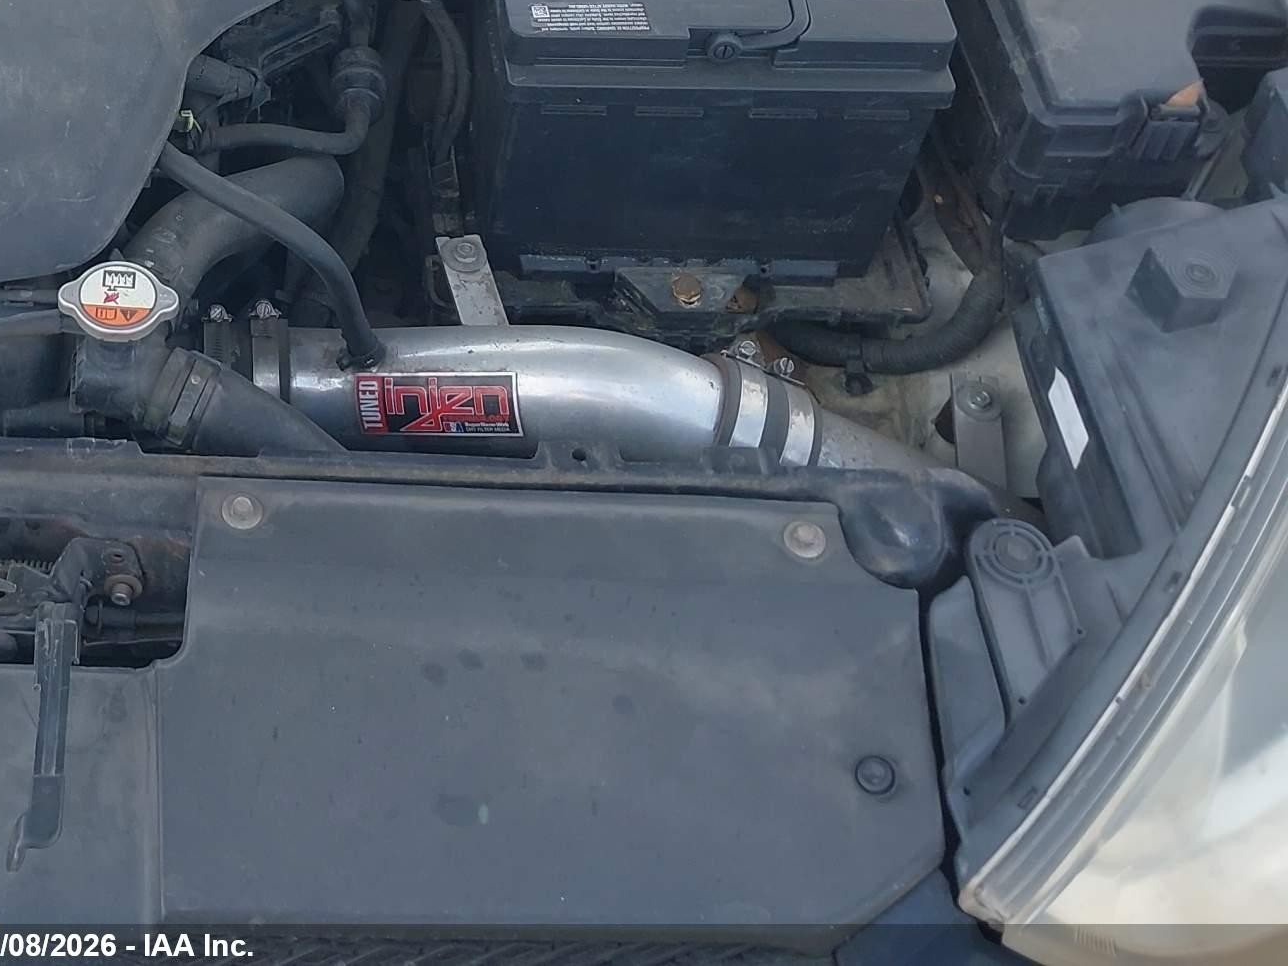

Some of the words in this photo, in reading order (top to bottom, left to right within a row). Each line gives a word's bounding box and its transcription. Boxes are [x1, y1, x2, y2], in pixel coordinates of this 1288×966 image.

[359, 381, 384, 430] TUNED
[384, 377, 511, 433] injen
[444, 422, 464, 433] USA
